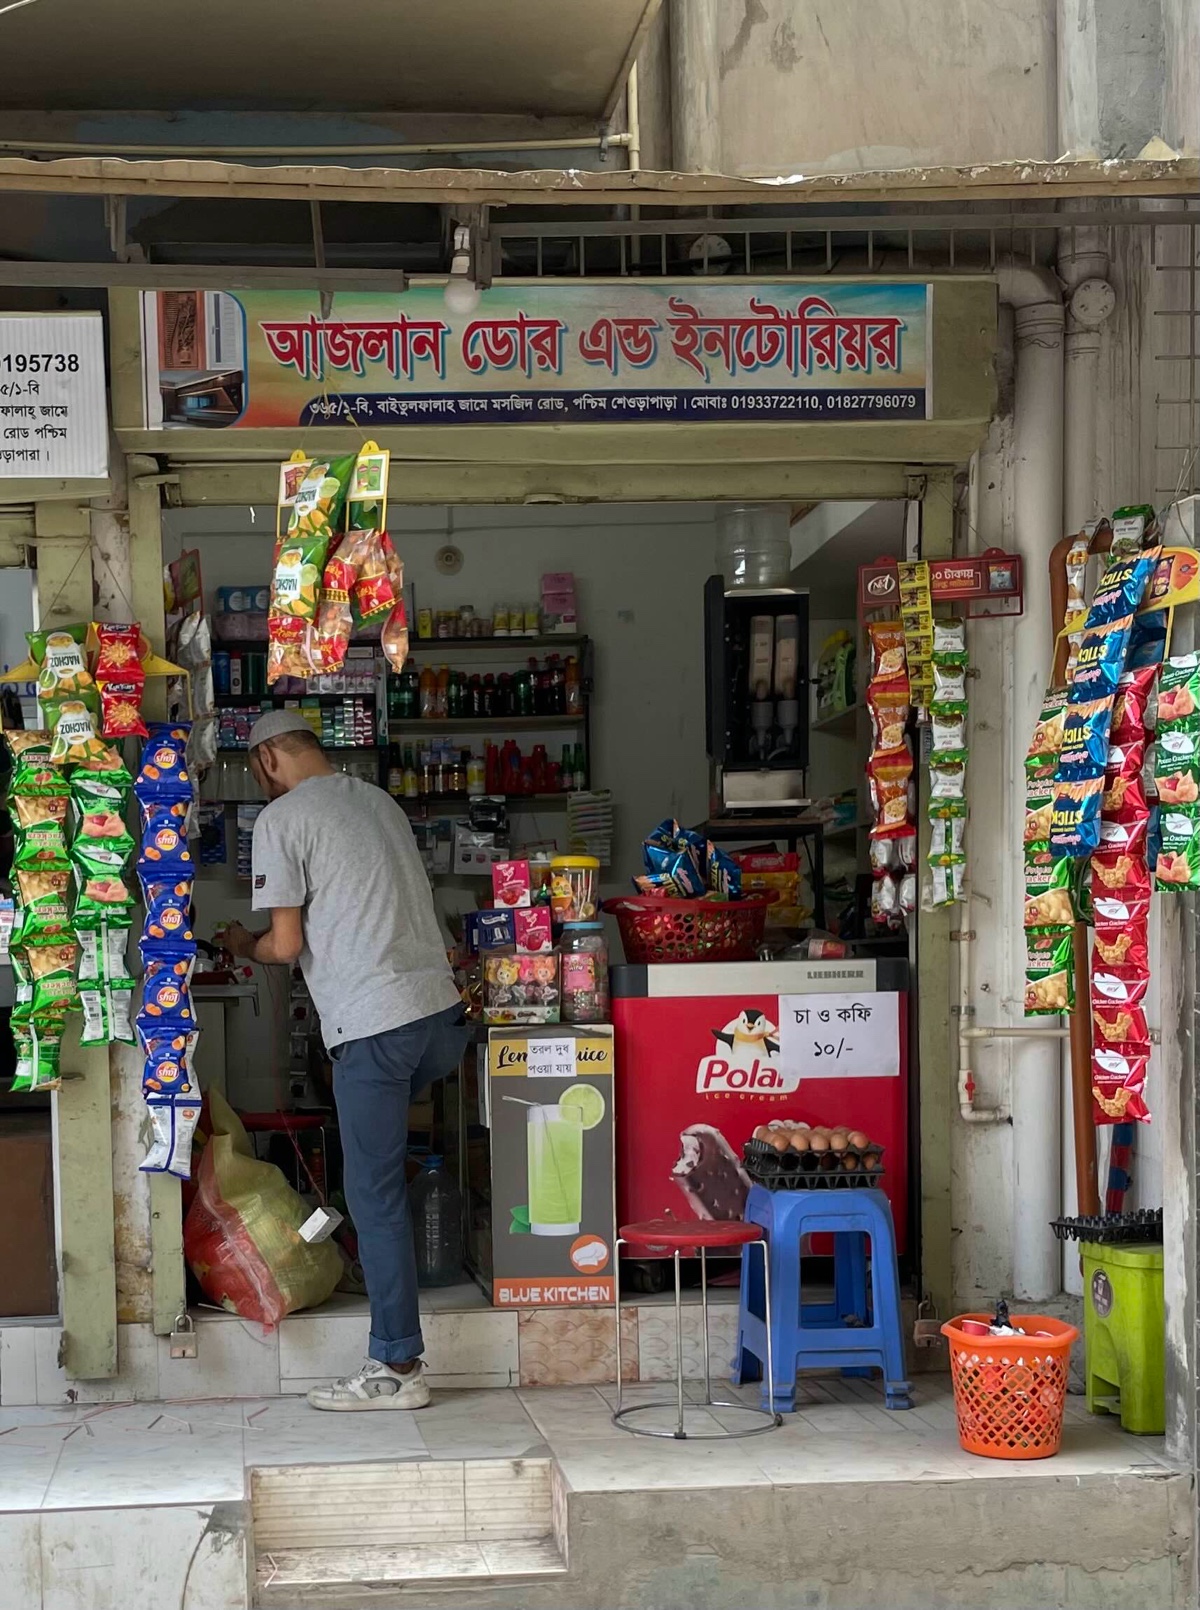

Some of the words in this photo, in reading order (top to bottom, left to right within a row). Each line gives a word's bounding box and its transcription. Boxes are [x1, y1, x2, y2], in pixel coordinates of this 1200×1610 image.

[260, 312, 448, 377] আজলান
[462, 310, 568, 376] ডোর
[579, 317, 660, 374] এন্ড
[666, 297, 905, 378] ইনটোরিয়র
[0, 353, 79, 373] 195738
[457, 397, 488, 411] জামে
[491, 394, 533, 412] মসজিদ
[537, 397, 569, 413] রোড,
[573, 393, 607, 410] পশ্চিম
[731, 395, 823, 411] 01933722110,
[826, 394, 916, 409] 01827796079
[39, 405, 68, 418] জামে
[4, 426, 30, 440] রোড
[35, 424, 67, 440] পশ্চিম
[0, 448, 40, 464] ড়াপারা
[1078, 644, 1106, 662] STIC
[50, 655, 81, 668] NACHOZ
[60, 722, 91, 735] NACHOZ
[793, 1009, 811, 1025] চা
[817, 1009, 831, 1023] ও
[835, 1002, 873, 1023] কফি
[529, 1044, 552, 1055] তরল
[555, 1044, 570, 1056] দুধ
[576, 1046, 608, 1062] uice
[813, 1037, 854, 1059] ১০/-
[555, 1063, 573, 1074] যায়
[499, 1287, 542, 1303] BLUE
[543, 1286, 610, 1302] KITCHEN
